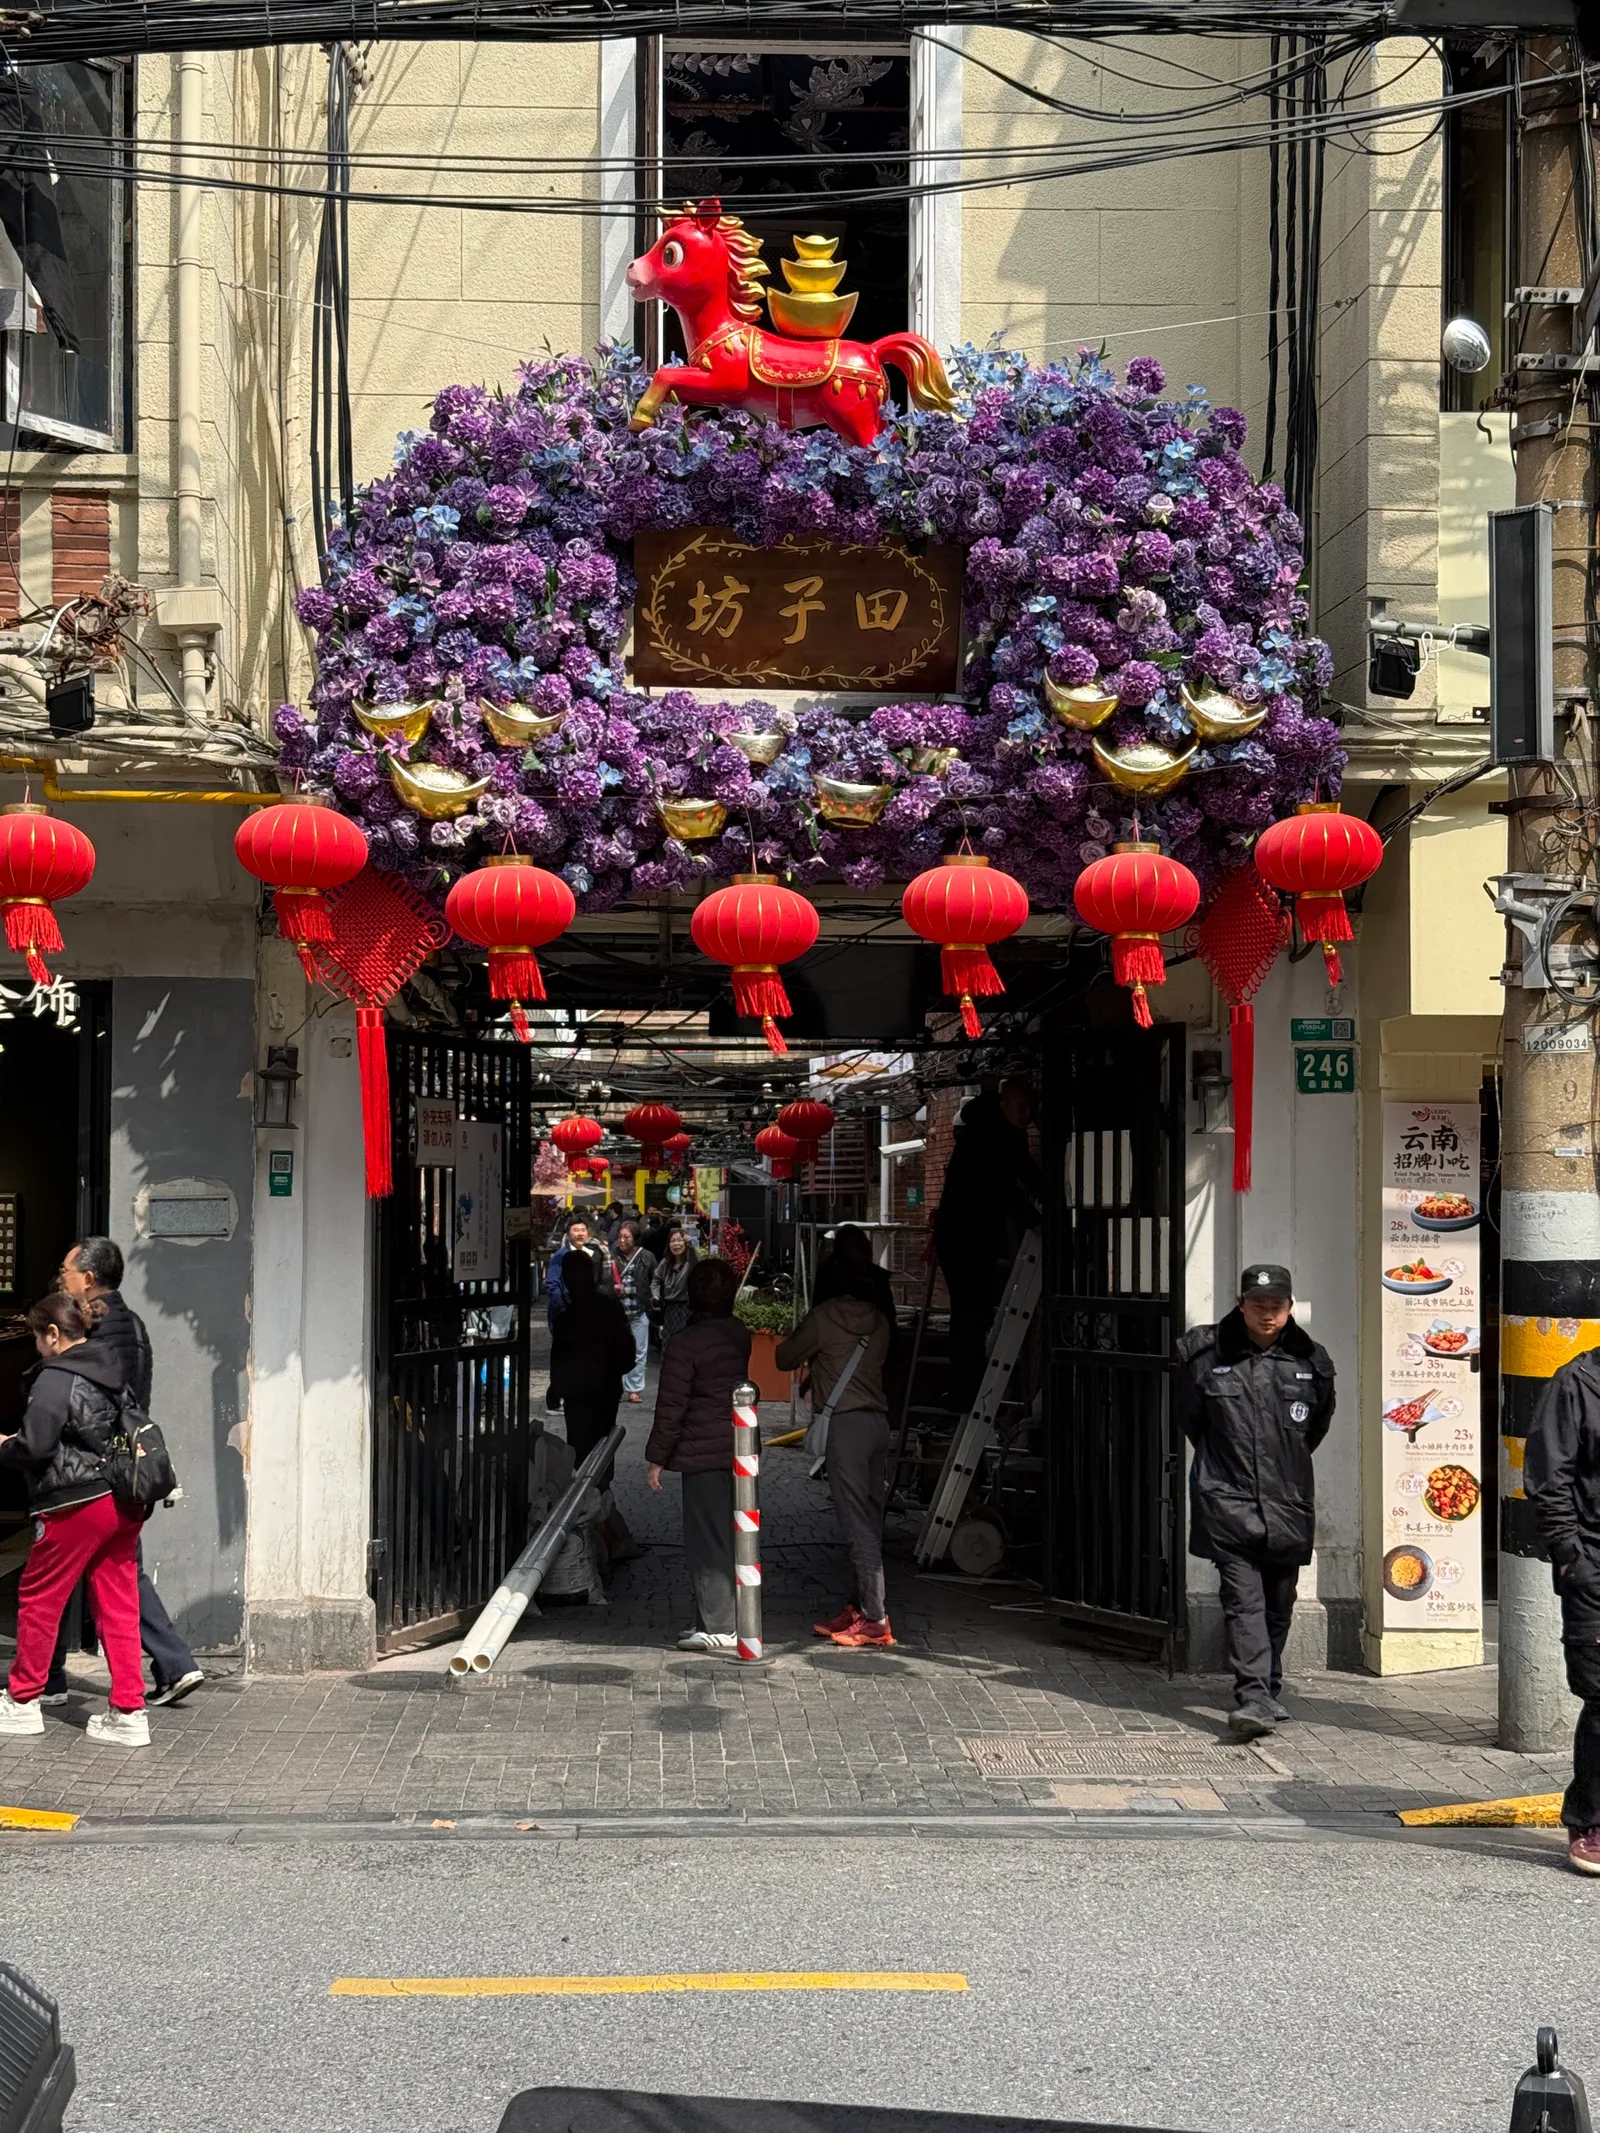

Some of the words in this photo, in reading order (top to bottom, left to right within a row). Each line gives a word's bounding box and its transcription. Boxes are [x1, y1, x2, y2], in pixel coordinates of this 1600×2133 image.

[1526, 1038, 1587, 1051] 12009034
[1303, 1053, 1349, 1077] 246
[423, 1108, 452, 1127] 外来车辆
[423, 1129, 452, 1148] 请勿入内
[1400, 1125, 1459, 1152] 云南
[1393, 1153, 1470, 1170] 招牌小吃
